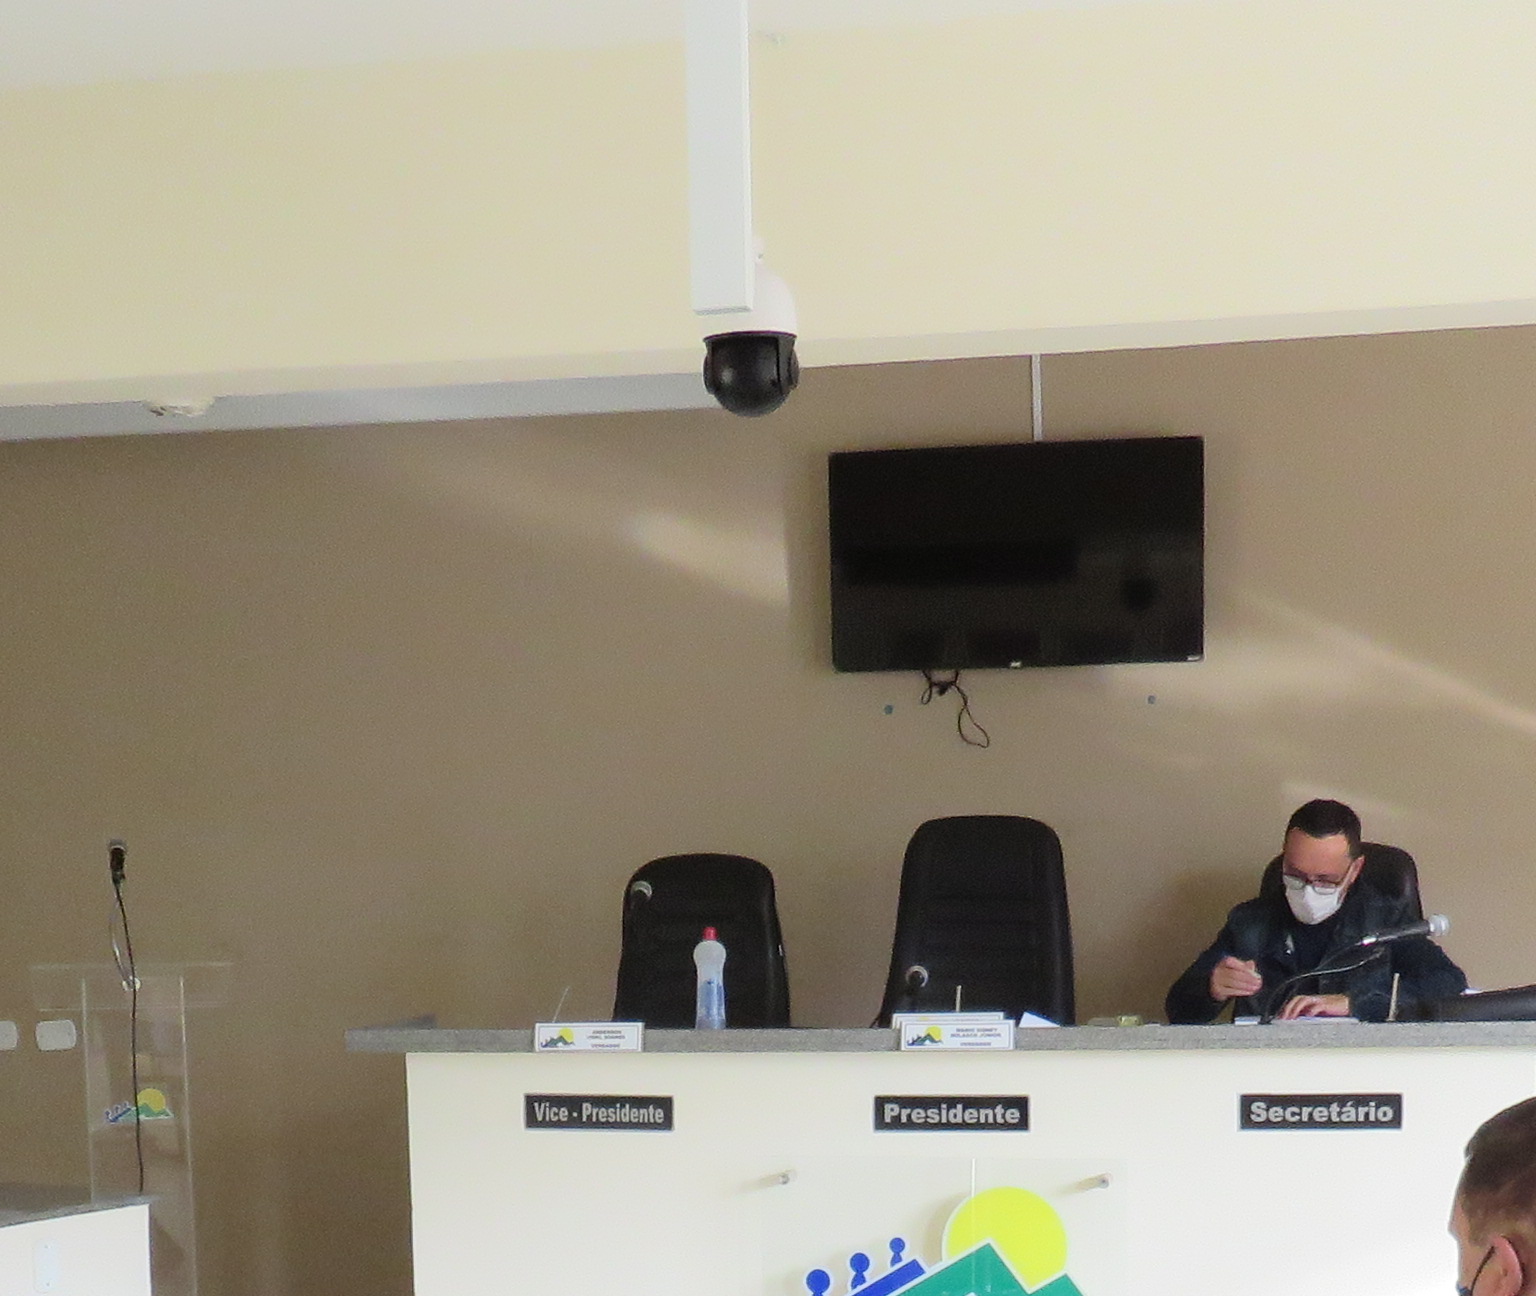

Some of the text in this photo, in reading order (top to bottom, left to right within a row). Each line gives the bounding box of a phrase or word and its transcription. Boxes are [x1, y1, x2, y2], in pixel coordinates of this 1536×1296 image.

[533, 1102, 569, 1122] Vice
[581, 1102, 664, 1124] Presidente
[883, 1103, 1021, 1124] Presidente
[1249, 1101, 1394, 1123] Secretário
